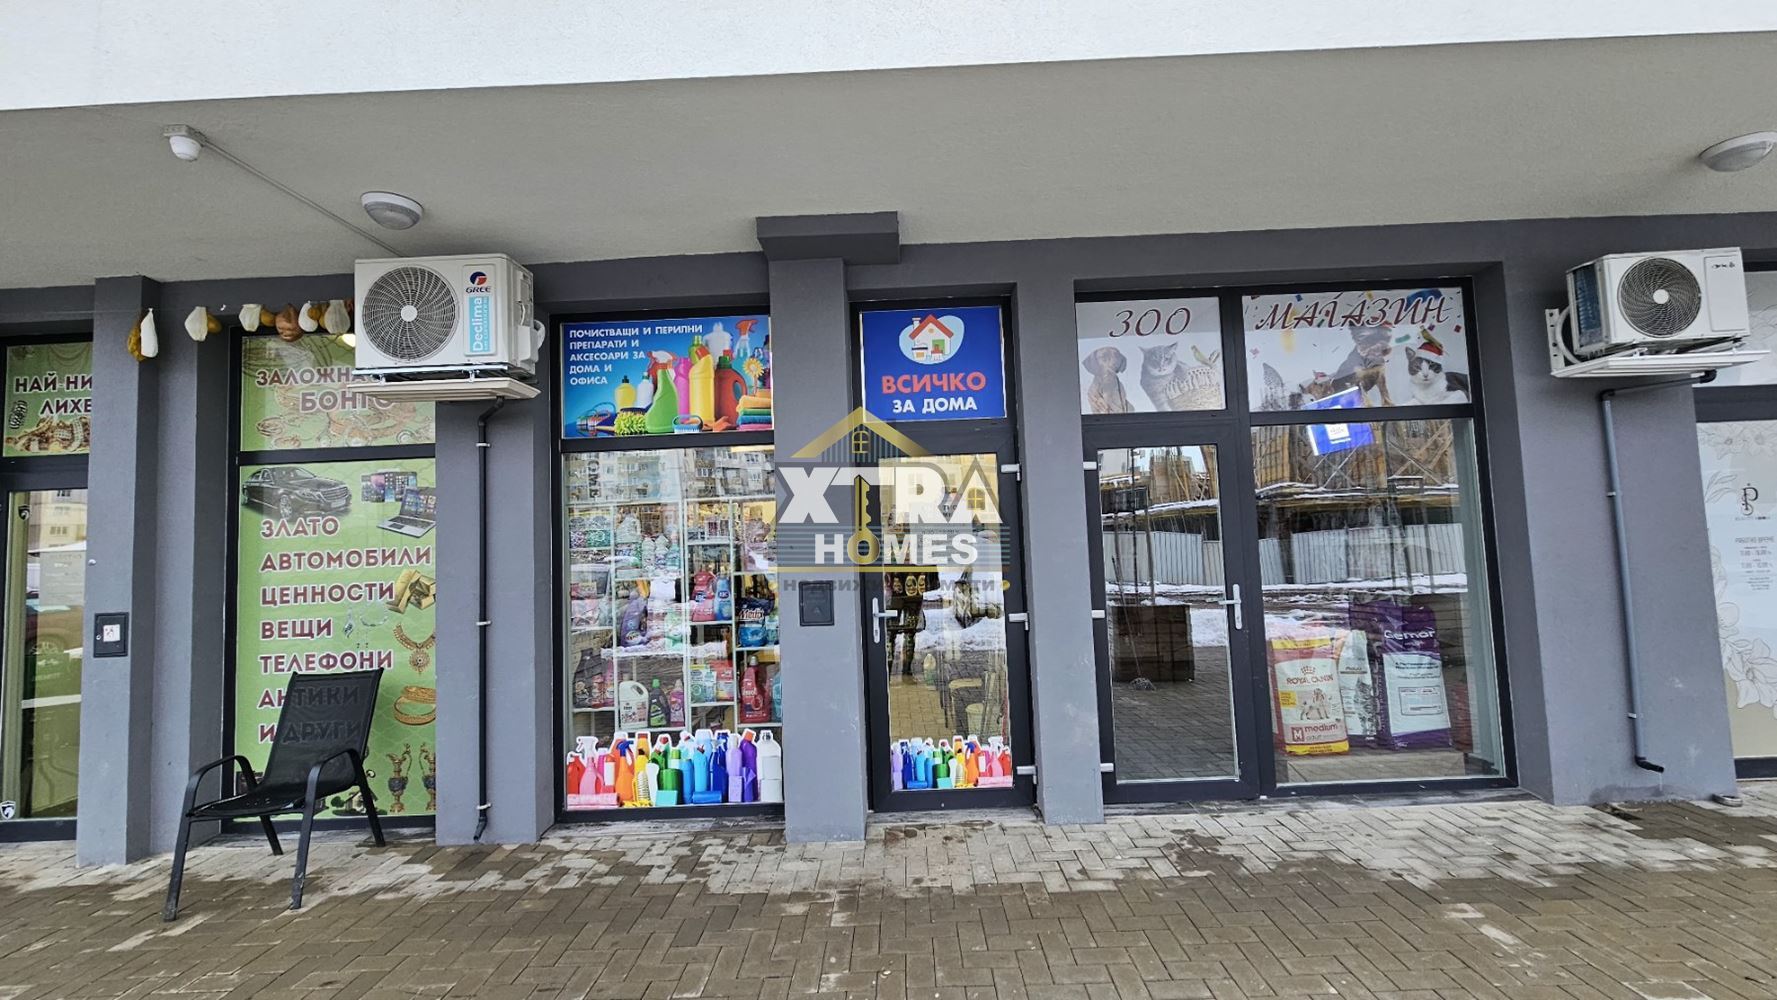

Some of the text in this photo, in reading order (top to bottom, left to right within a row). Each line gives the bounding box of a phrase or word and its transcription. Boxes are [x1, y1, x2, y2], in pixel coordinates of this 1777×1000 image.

[472, 297, 483, 352] Declima
[1109, 296, 1450, 338] ЗОО МАГАЗИН
[569, 325, 703, 339] ПОЧИСТВАЩИ И ПЕРИЛНИ
[569, 339, 640, 350] ПРЕПАРАТИ И
[569, 351, 646, 362] АКСЕСОАРИ ЗА
[569, 364, 613, 375] ДОМА И
[569, 376, 608, 386] ОФИСА
[881, 371, 987, 394] ВСИЧКО
[892, 397, 977, 414] ЗА ДОМА
[261, 516, 339, 538] ЗЛАТО
[260, 547, 431, 571] АВТОМОБИЛИ
[261, 582, 394, 606] ЦЕННОСТИ
[261, 619, 332, 640] ВЕЩИ
[260, 650, 393, 673] ТЕЛЕФОНИ
[260, 724, 275, 742] И
